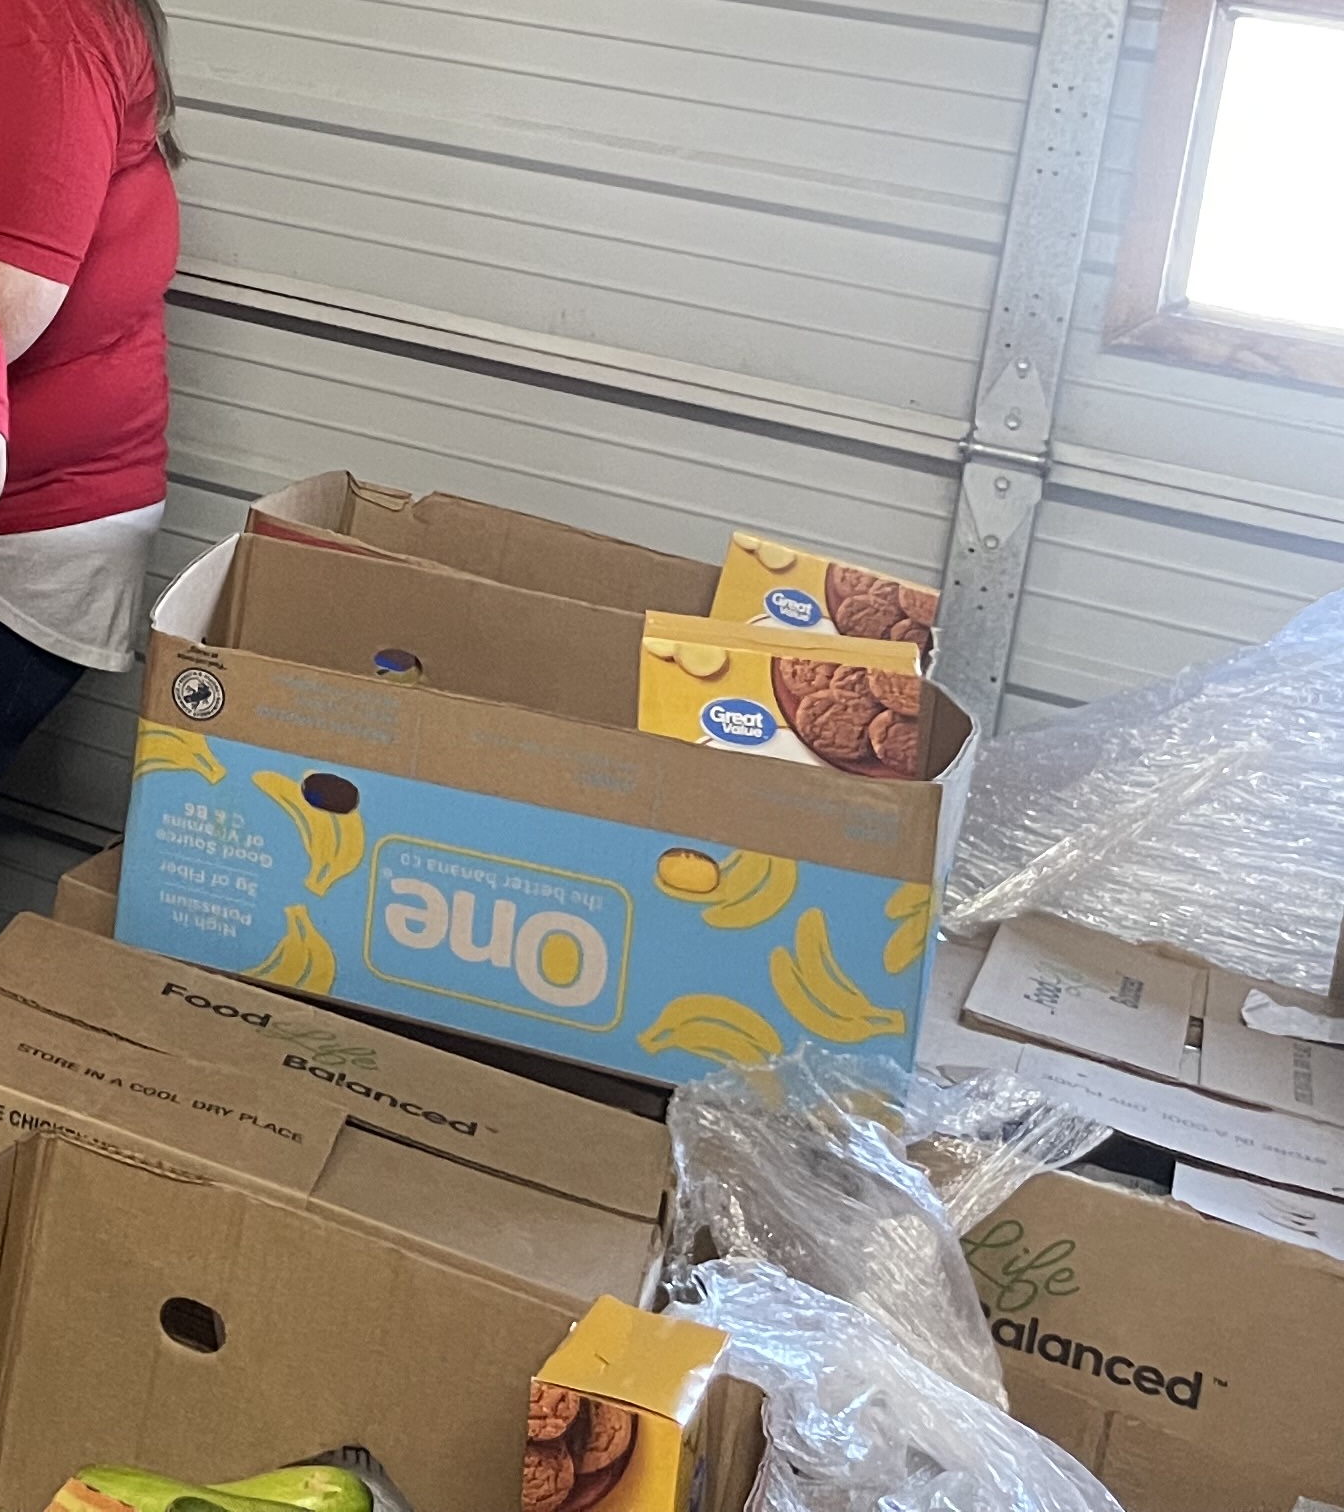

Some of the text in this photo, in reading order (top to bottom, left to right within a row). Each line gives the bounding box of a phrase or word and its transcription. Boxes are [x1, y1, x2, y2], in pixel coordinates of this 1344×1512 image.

[771, 592, 813, 615] Great
[710, 706, 765, 727] Great
[723, 721, 763, 738] Value
[156, 828, 273, 868] Good Source
[159, 860, 205, 883] Fiber
[400, 853, 604, 912] the better banana co
[160, 890, 252, 926] Potassium
[384, 878, 608, 1007] One
[161, 982, 272, 1028] Food
[16, 1042, 303, 1144] STORE IN A COOL DRY PLACE
[282, 1053, 477, 1137] Balanced
[959, 1219, 1080, 1313] Life
[980, 1301, 1203, 1410] alanced
